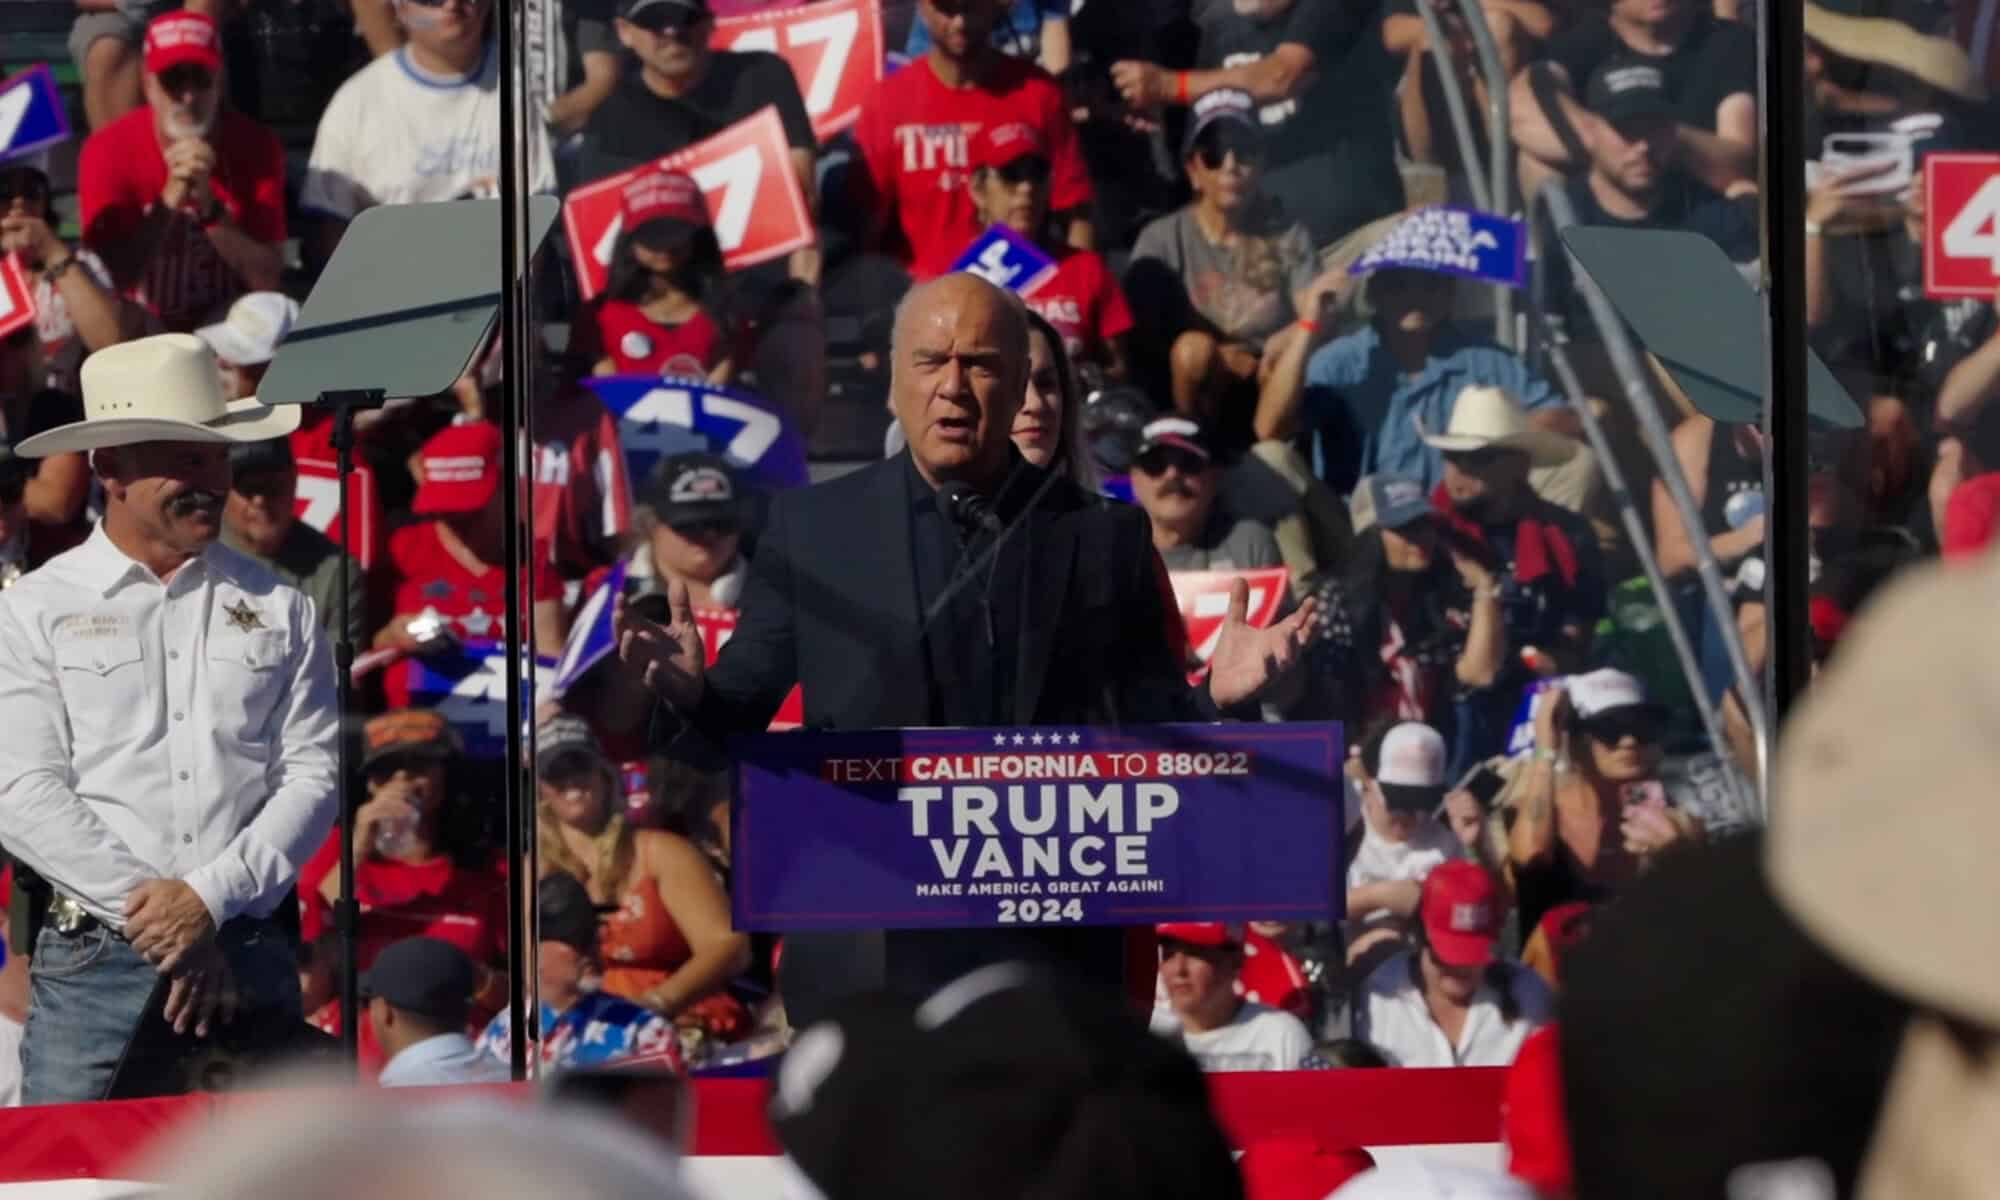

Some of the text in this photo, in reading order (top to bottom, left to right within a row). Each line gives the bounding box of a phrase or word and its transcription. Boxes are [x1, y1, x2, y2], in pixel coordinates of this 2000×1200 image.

[729, 12, 858, 113] 7
[593, 144, 763, 264] 7
[1941, 173, 2000, 277] 4
[619, 387, 781, 468] 47
[827, 752, 1249, 781] TEXT CALIFORNIA TO 88022
[898, 782, 1180, 836] TRUMP
[929, 835, 1148, 879] VANCE
[916, 880, 1165, 896] MAKE AMERICA GREAT AGAIN!
[998, 898, 1084, 923] 2024
